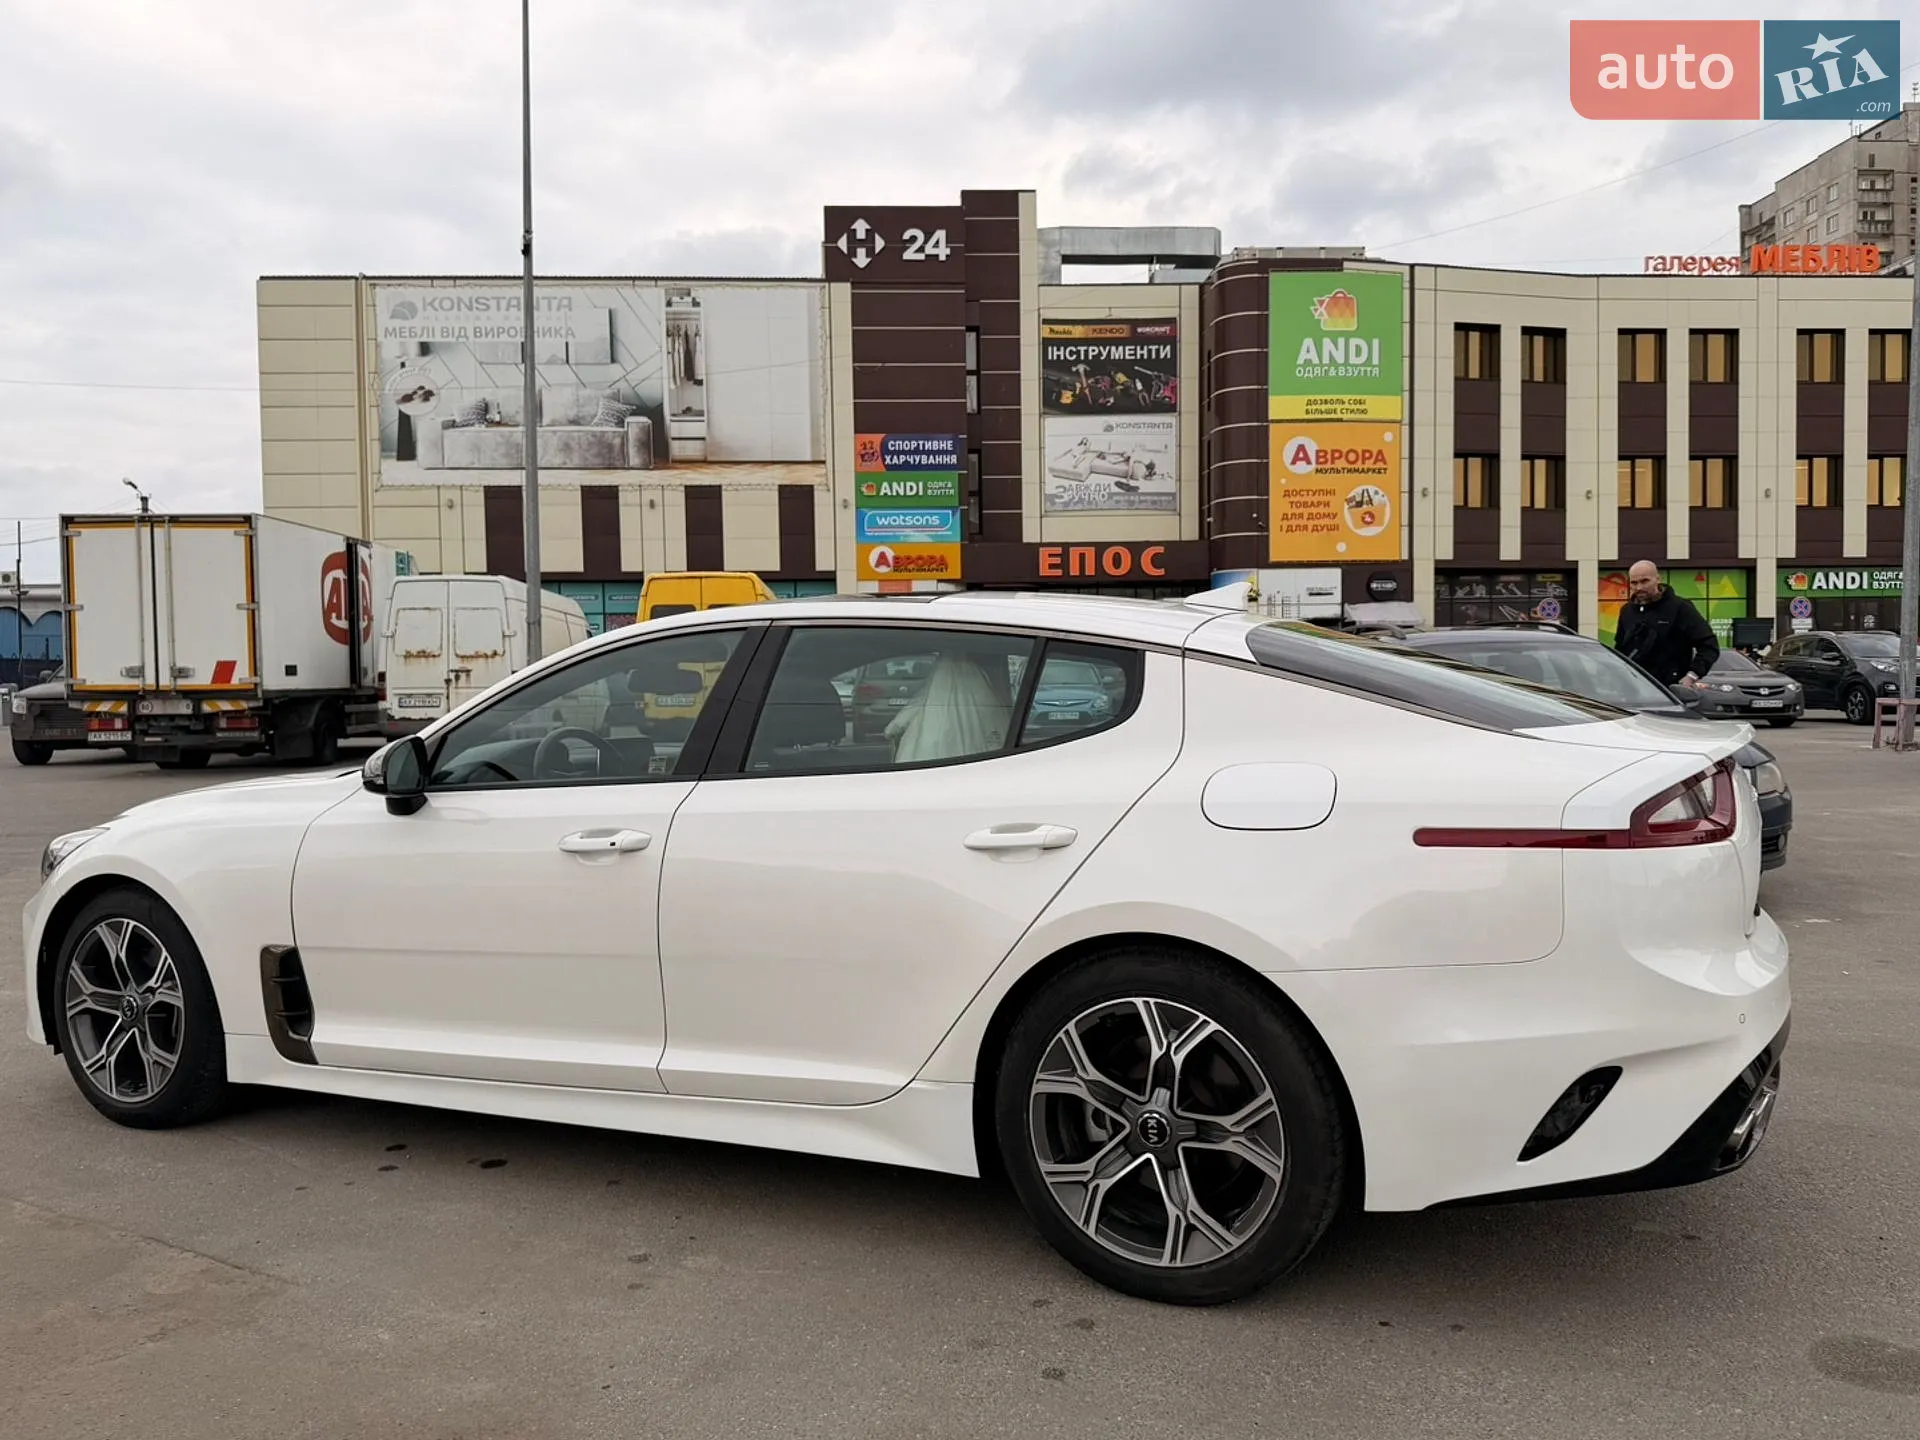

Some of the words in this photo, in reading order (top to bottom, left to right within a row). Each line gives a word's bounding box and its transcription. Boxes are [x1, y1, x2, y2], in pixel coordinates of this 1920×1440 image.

[902, 228, 951, 261] 24
[1644, 254, 1741, 274] галерея
[1751, 244, 1881, 273] МЕБЛІВ
[384, 326, 436, 339] МЕБЛІ
[440, 326, 469, 341] ВІД
[1047, 344, 1172, 361] ІНСТРУМЕНТИ
[1296, 337, 1380, 366] ANDI
[1305, 398, 1345, 406] ДОЗВОЛЬ
[1347, 398, 1367, 406] СОБІ
[1305, 407, 1338, 416] БІЛЬШЕ
[1340, 407, 1369, 416] СТИЛЮ
[887, 440, 954, 451] СПОРТИВНЕ
[884, 454, 958, 465] ХАРЧУВАННЯ
[1289, 443, 1388, 466] АВРОРА
[1314, 466, 1388, 476] МУЛЬТИМАРКЕТ
[880, 481, 924, 497] ANDI
[1282, 488, 1336, 499] ДОСТУПНІ
[1288, 500, 1331, 509] ТОВАРИ
[876, 514, 941, 526] watsons
[1281, 511, 1304, 521] ДЛЯ
[1306, 511, 1338, 521] ДОМУ
[1285, 523, 1308, 534] ДЛЯ
[1310, 523, 1340, 534] ДУШІ
[1039, 545, 1165, 577] ЕПОС
[1811, 571, 1868, 590] ANDI
[1147, 1118, 1159, 1143] KIA
